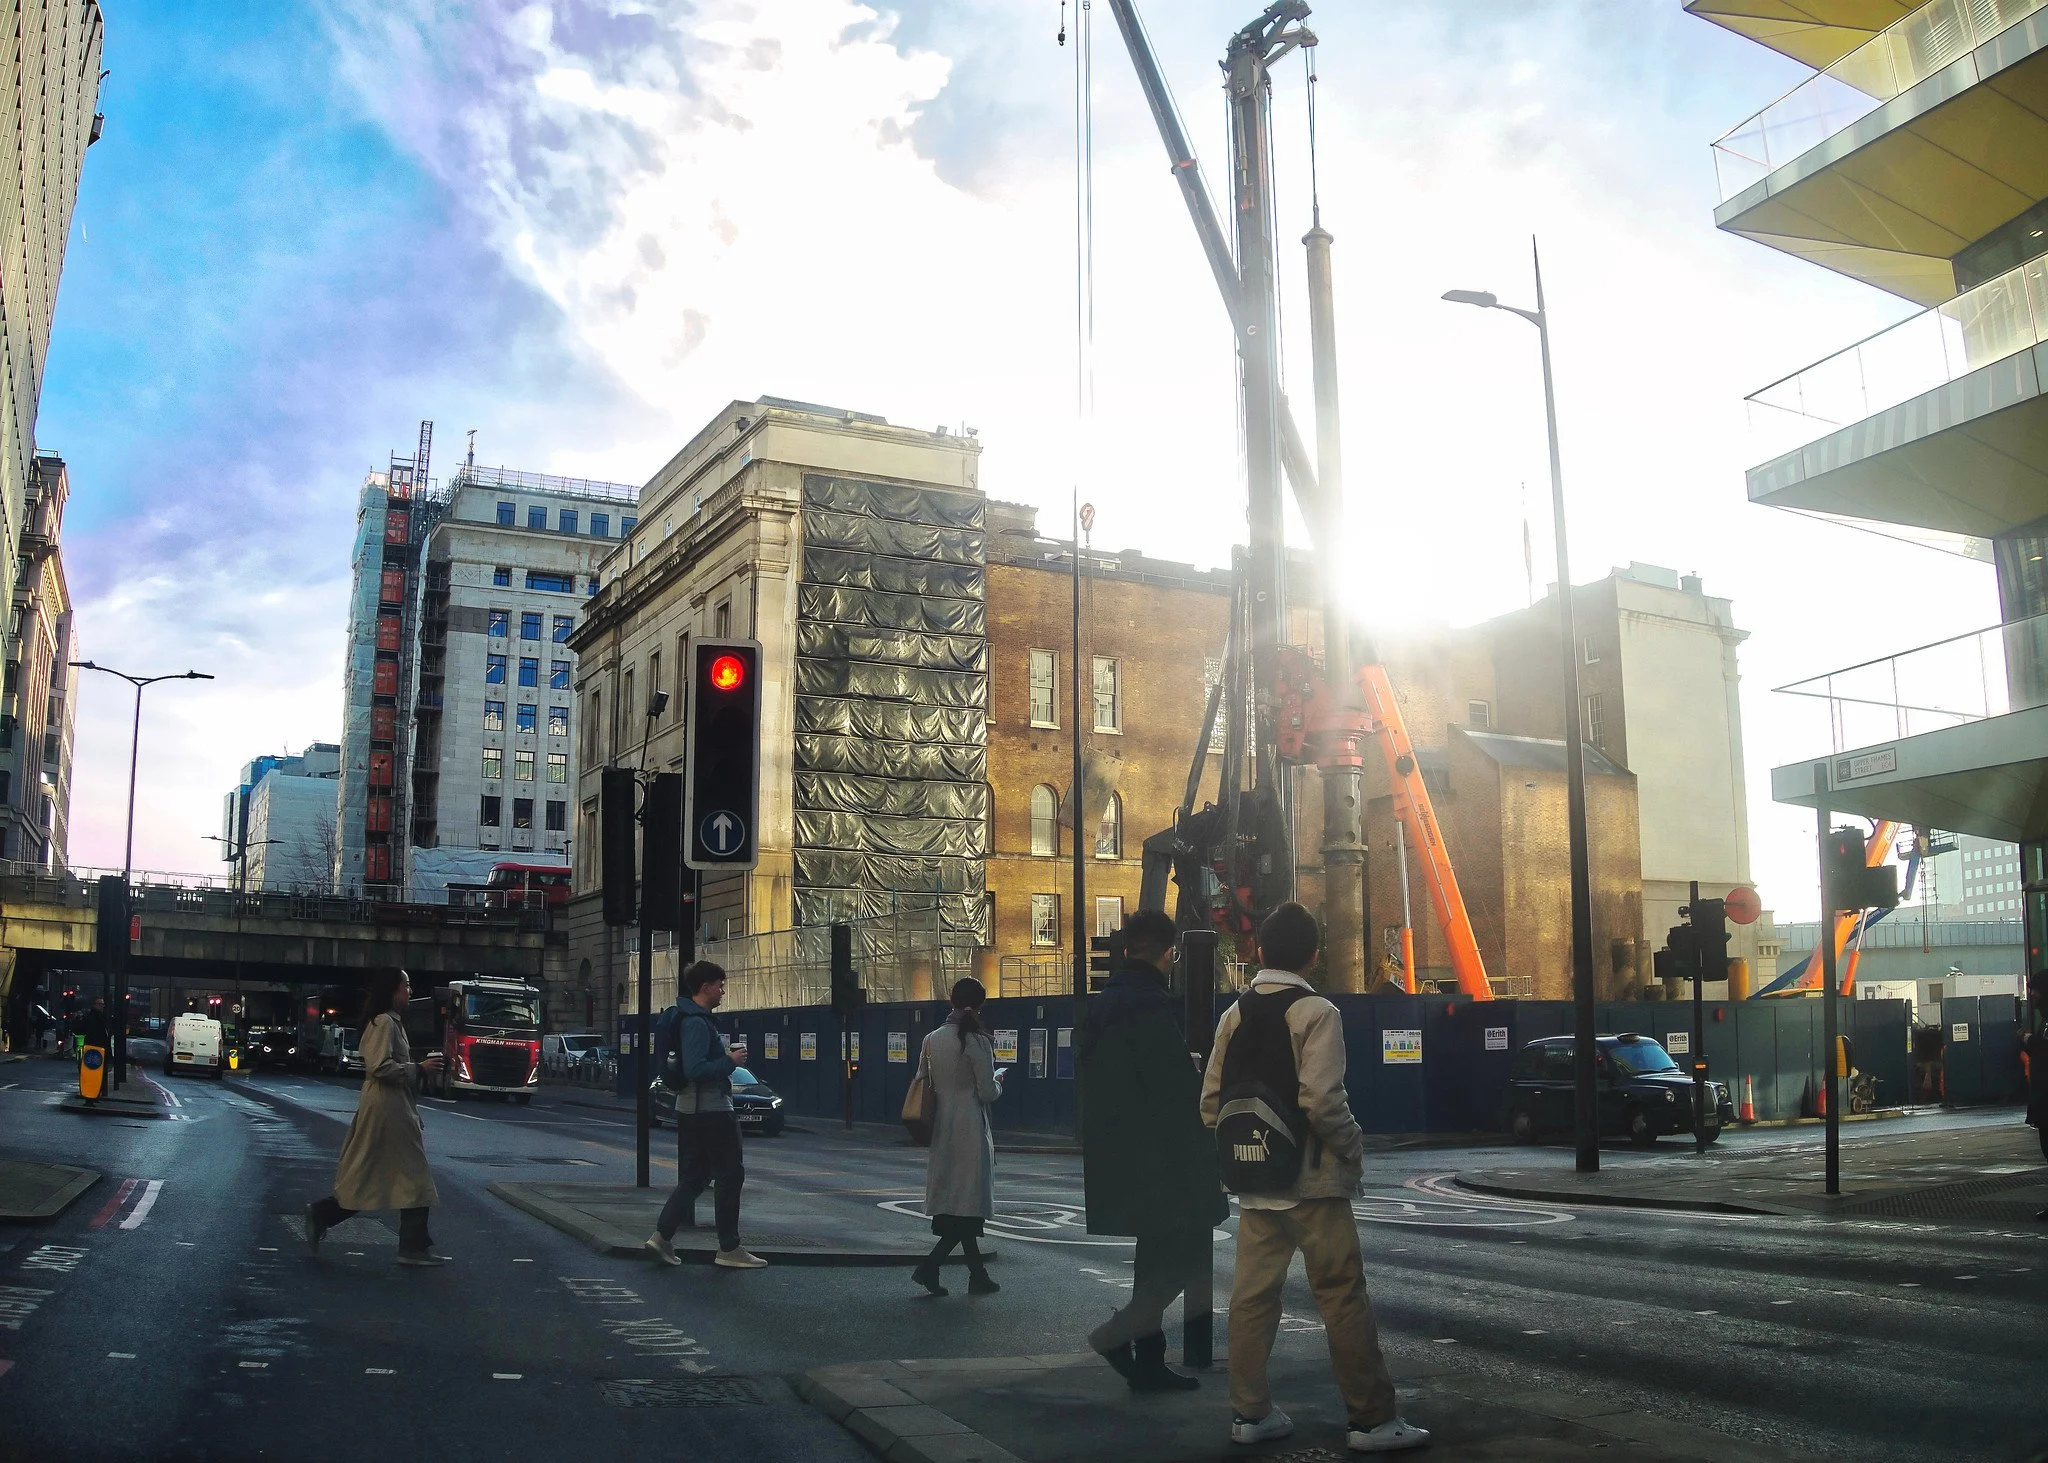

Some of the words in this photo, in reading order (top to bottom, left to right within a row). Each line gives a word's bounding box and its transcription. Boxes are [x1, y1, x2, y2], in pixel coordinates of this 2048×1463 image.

[1870, 752, 1892, 764] THAMES
[1854, 764, 1873, 775] STREET
[475, 1038, 505, 1046] KINGMAN
[1233, 1144, 1266, 1162] PUMA
[20, 1244, 90, 1272] LOOK
[601, 1317, 710, 1356] LOOK
